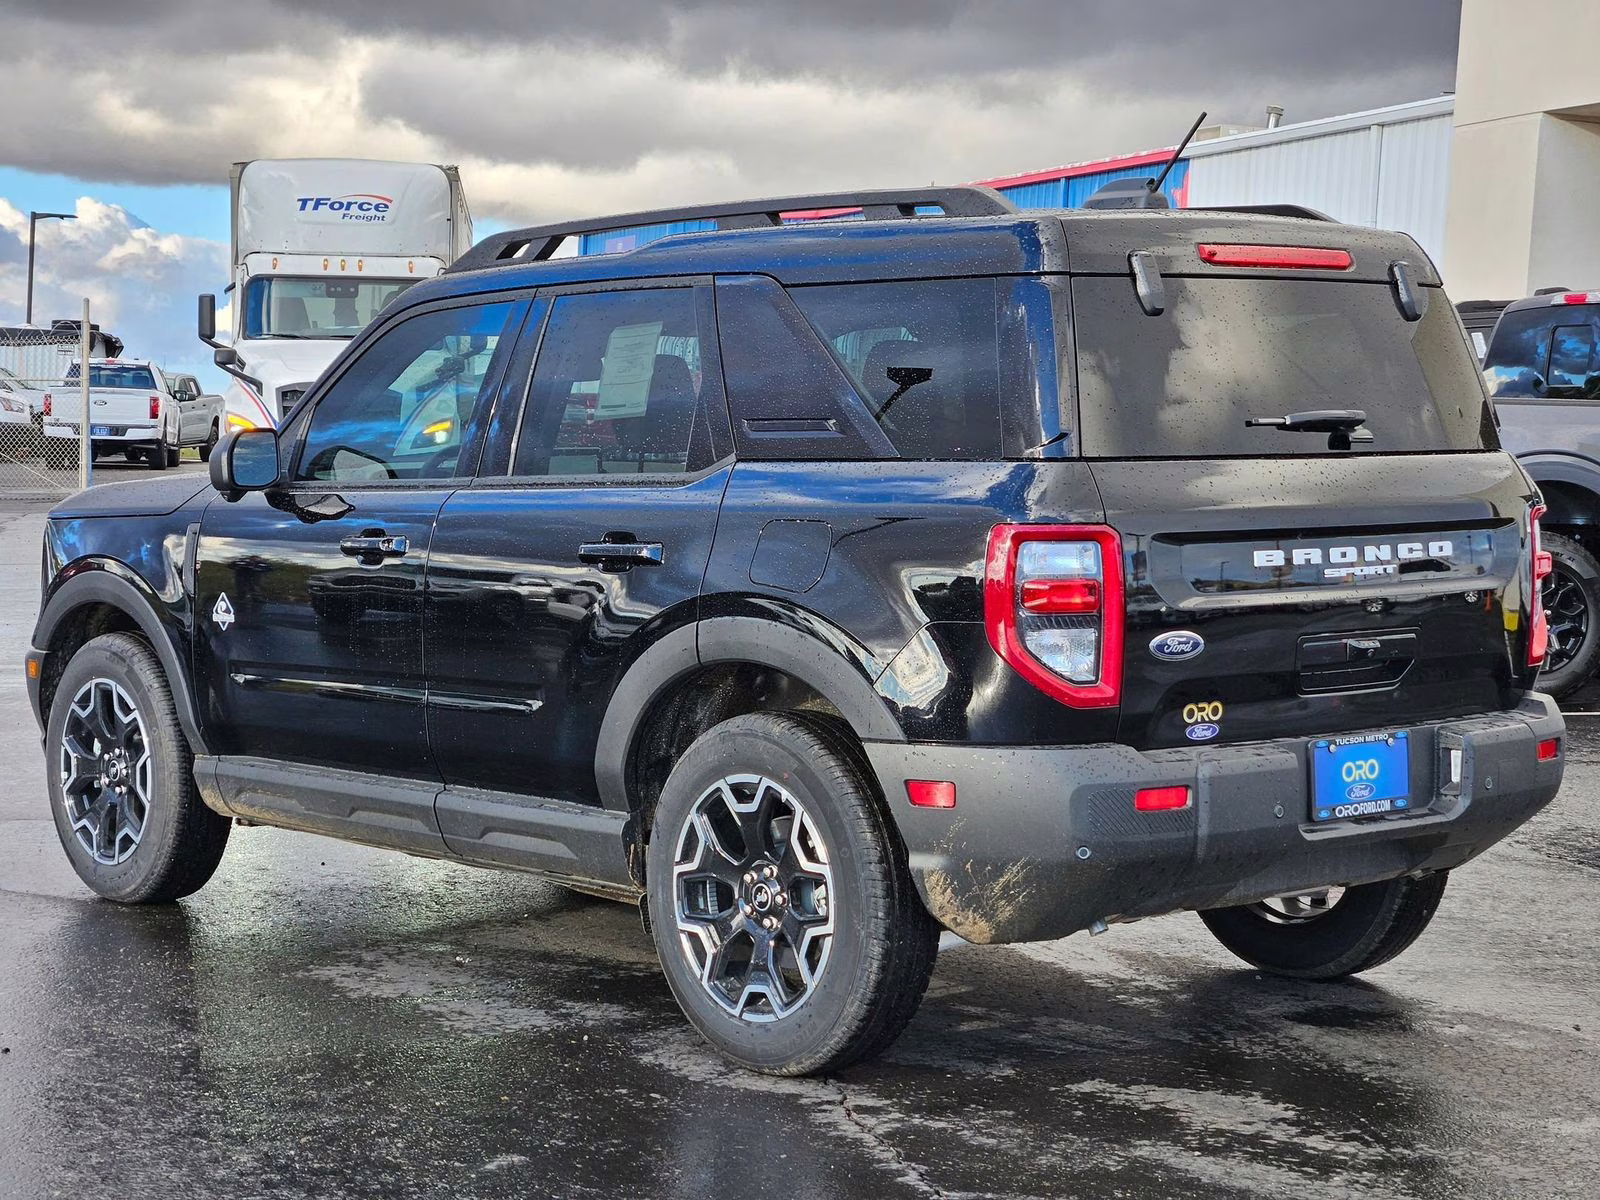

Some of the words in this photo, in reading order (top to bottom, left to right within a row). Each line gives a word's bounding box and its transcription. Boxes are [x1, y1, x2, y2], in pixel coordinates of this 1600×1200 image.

[296, 198, 390, 213] TForce
[341, 213, 387, 222] Freight
[1253, 541, 1453, 567] BRONCO
[1324, 564, 1397, 578] SPORT
[1164, 637, 1194, 653] Ford
[1183, 701, 1223, 723] ORO
[1192, 726, 1213, 738] Ford
[1335, 737, 1365, 746] TUCSON
[1365, 733, 1389, 743] METRO
[1342, 758, 1379, 782] ORO
[1350, 784, 1371, 798] Ford
[1335, 800, 1391, 818] OROFORD.COM
